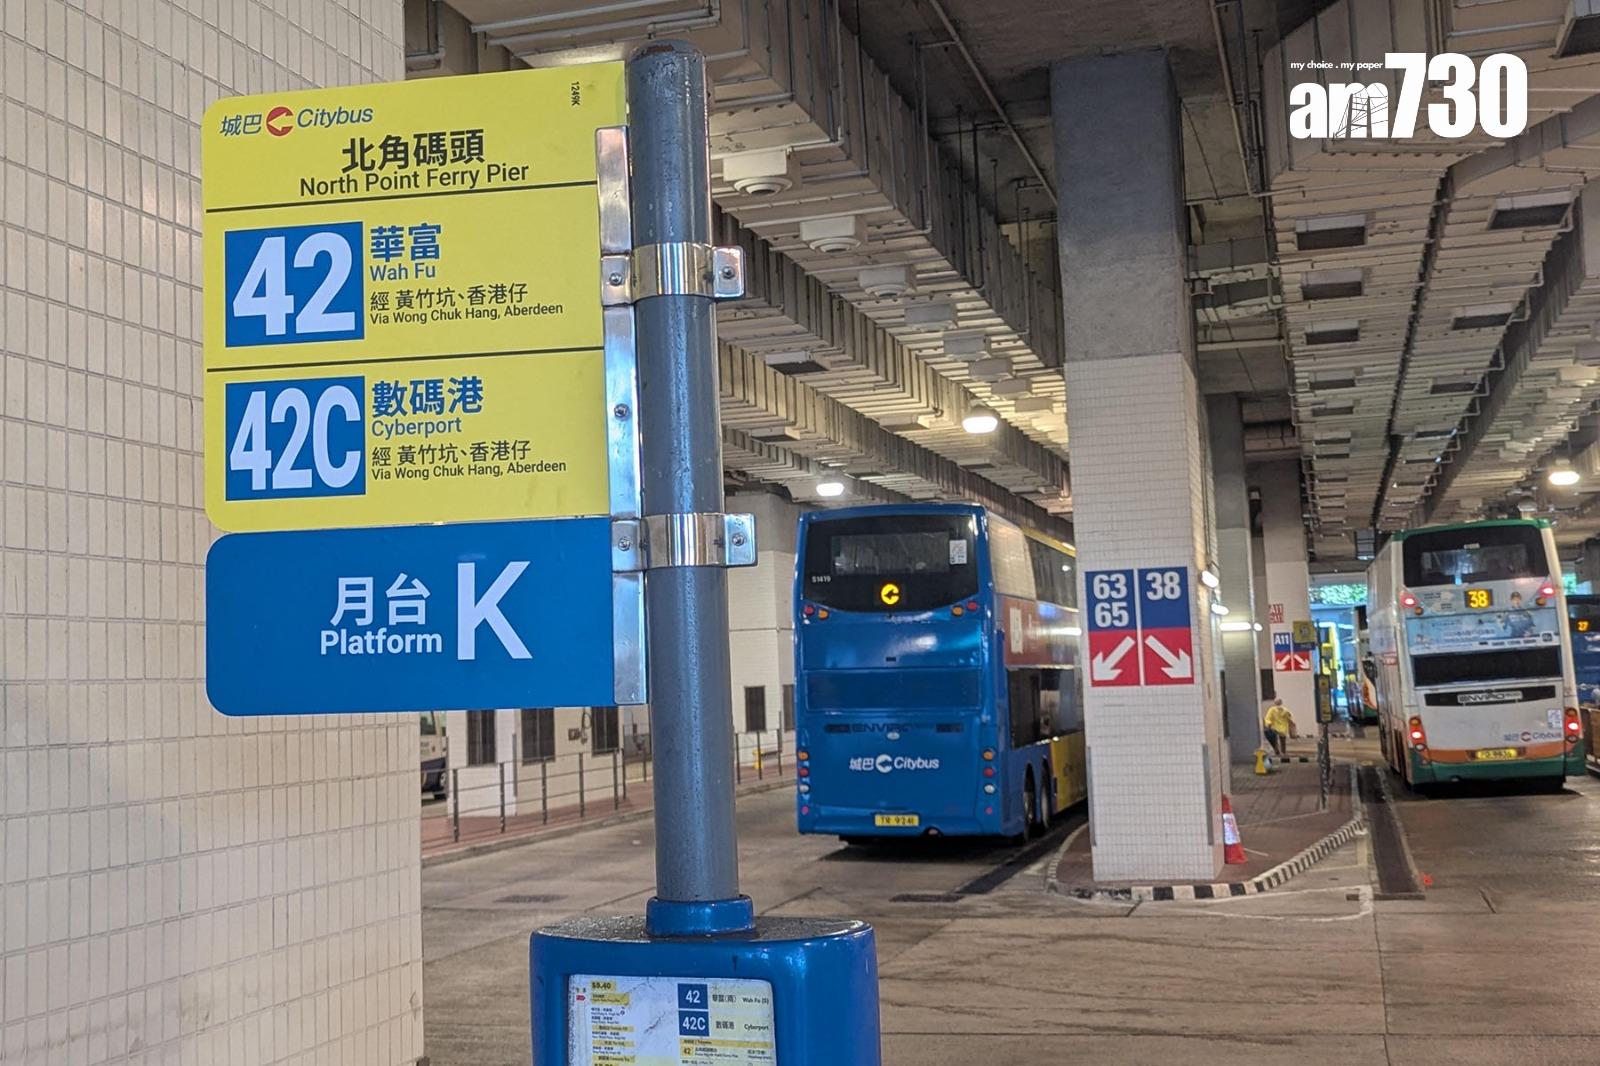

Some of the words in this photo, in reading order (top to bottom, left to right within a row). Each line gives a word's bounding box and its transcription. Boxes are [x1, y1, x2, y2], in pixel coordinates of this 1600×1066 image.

[570, 81, 581, 106] 1249K
[220, 113, 262, 137] 城巴
[296, 106, 374, 129] Citybus
[341, 128, 485, 174] 北角碼頭
[300, 175, 358, 196] North
[365, 171, 420, 192] Point
[426, 165, 481, 192] Ferry
[487, 162, 529, 184] Pier
[370, 222, 443, 263] 華富
[232, 231, 356, 336] 42
[370, 264, 409, 282] Wah
[415, 261, 436, 280] Fu
[370, 291, 390, 311] 經
[370, 312, 389, 325] Via
[393, 310, 428, 326] Wong
[431, 308, 462, 322] Chuk
[465, 306, 502, 323] Hang,
[504, 302, 563, 318] Aberdeen
[371, 375, 484, 419] 數碼港
[229, 384, 361, 491] 42C
[371, 418, 462, 440] Cyberport
[371, 446, 392, 467] 經
[371, 467, 391, 481] Via
[395, 466, 430, 482] Wong
[433, 464, 465, 478] Chuk
[467, 462, 503, 478] Hang,
[506, 460, 567, 474] Aberdeen
[1093, 573, 1128, 600] 63
[1146, 571, 1181, 600] 38
[330, 573, 431, 628] 月台
[456, 561, 533, 661] K
[1468, 590, 1489, 608] 38
[1094, 601, 1129, 628] 65
[320, 627, 443, 656] Platform
[1275, 634, 1290, 645] A11
[849, 757, 874, 771] 城巴
[894, 756, 940, 770] Citybus
[685, 990, 701, 1003] 42
[682, 1016, 706, 1030] 42C
[744, 1023, 769, 1031] Cyberport
